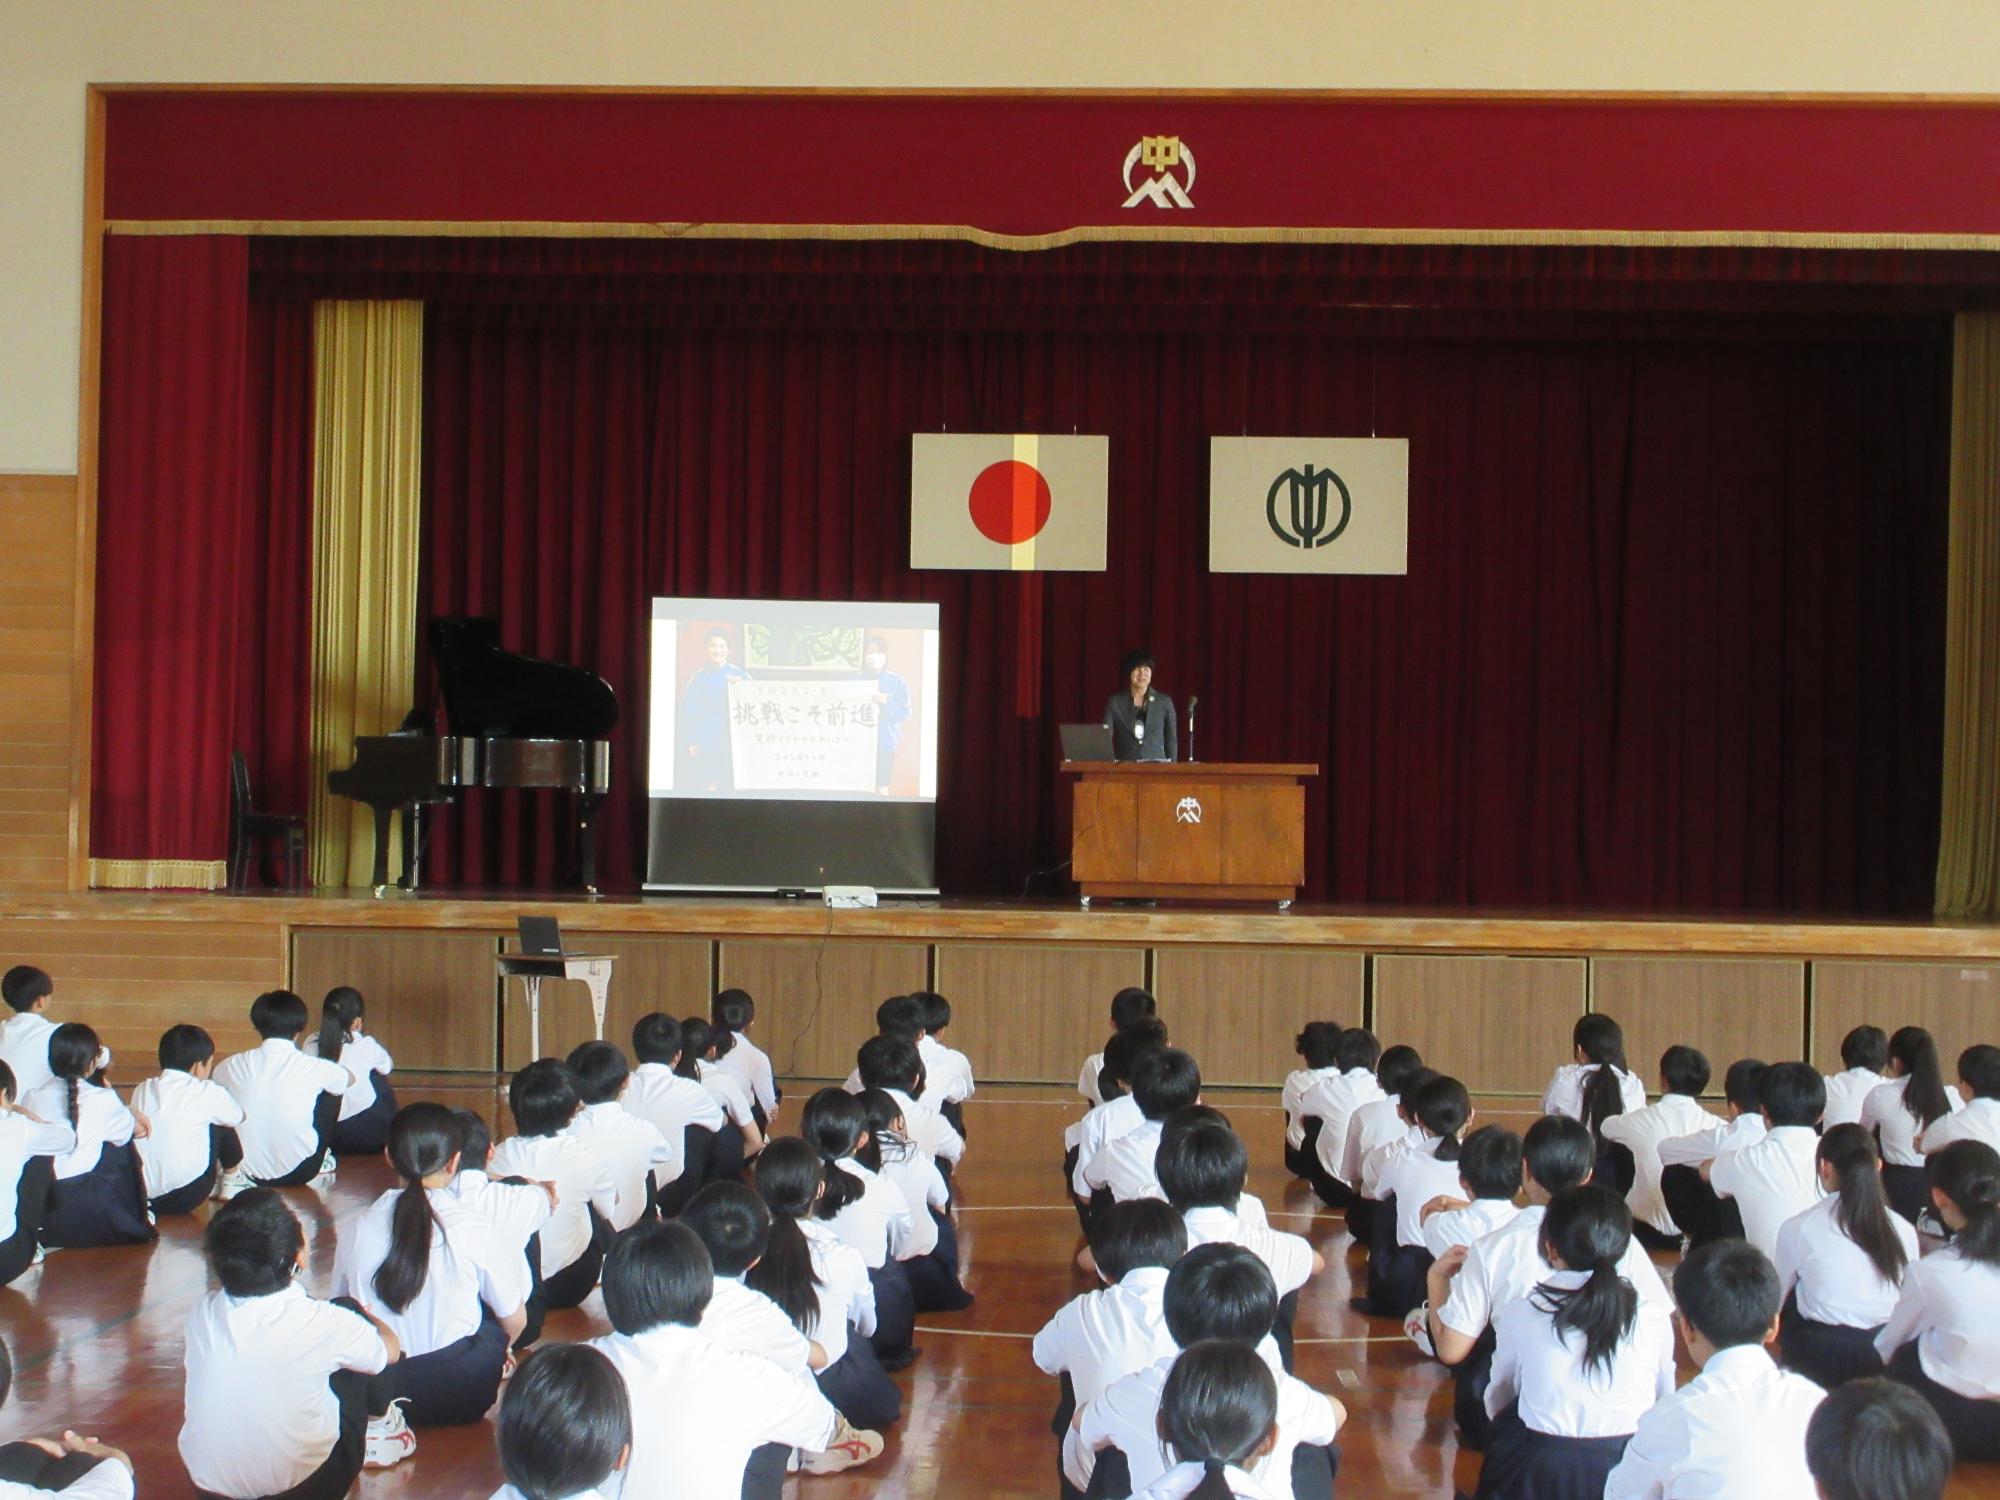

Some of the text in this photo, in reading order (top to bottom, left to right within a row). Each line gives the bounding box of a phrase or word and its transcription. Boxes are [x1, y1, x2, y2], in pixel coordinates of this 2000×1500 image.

[733, 700, 879, 728] 挑戦こそ前進
